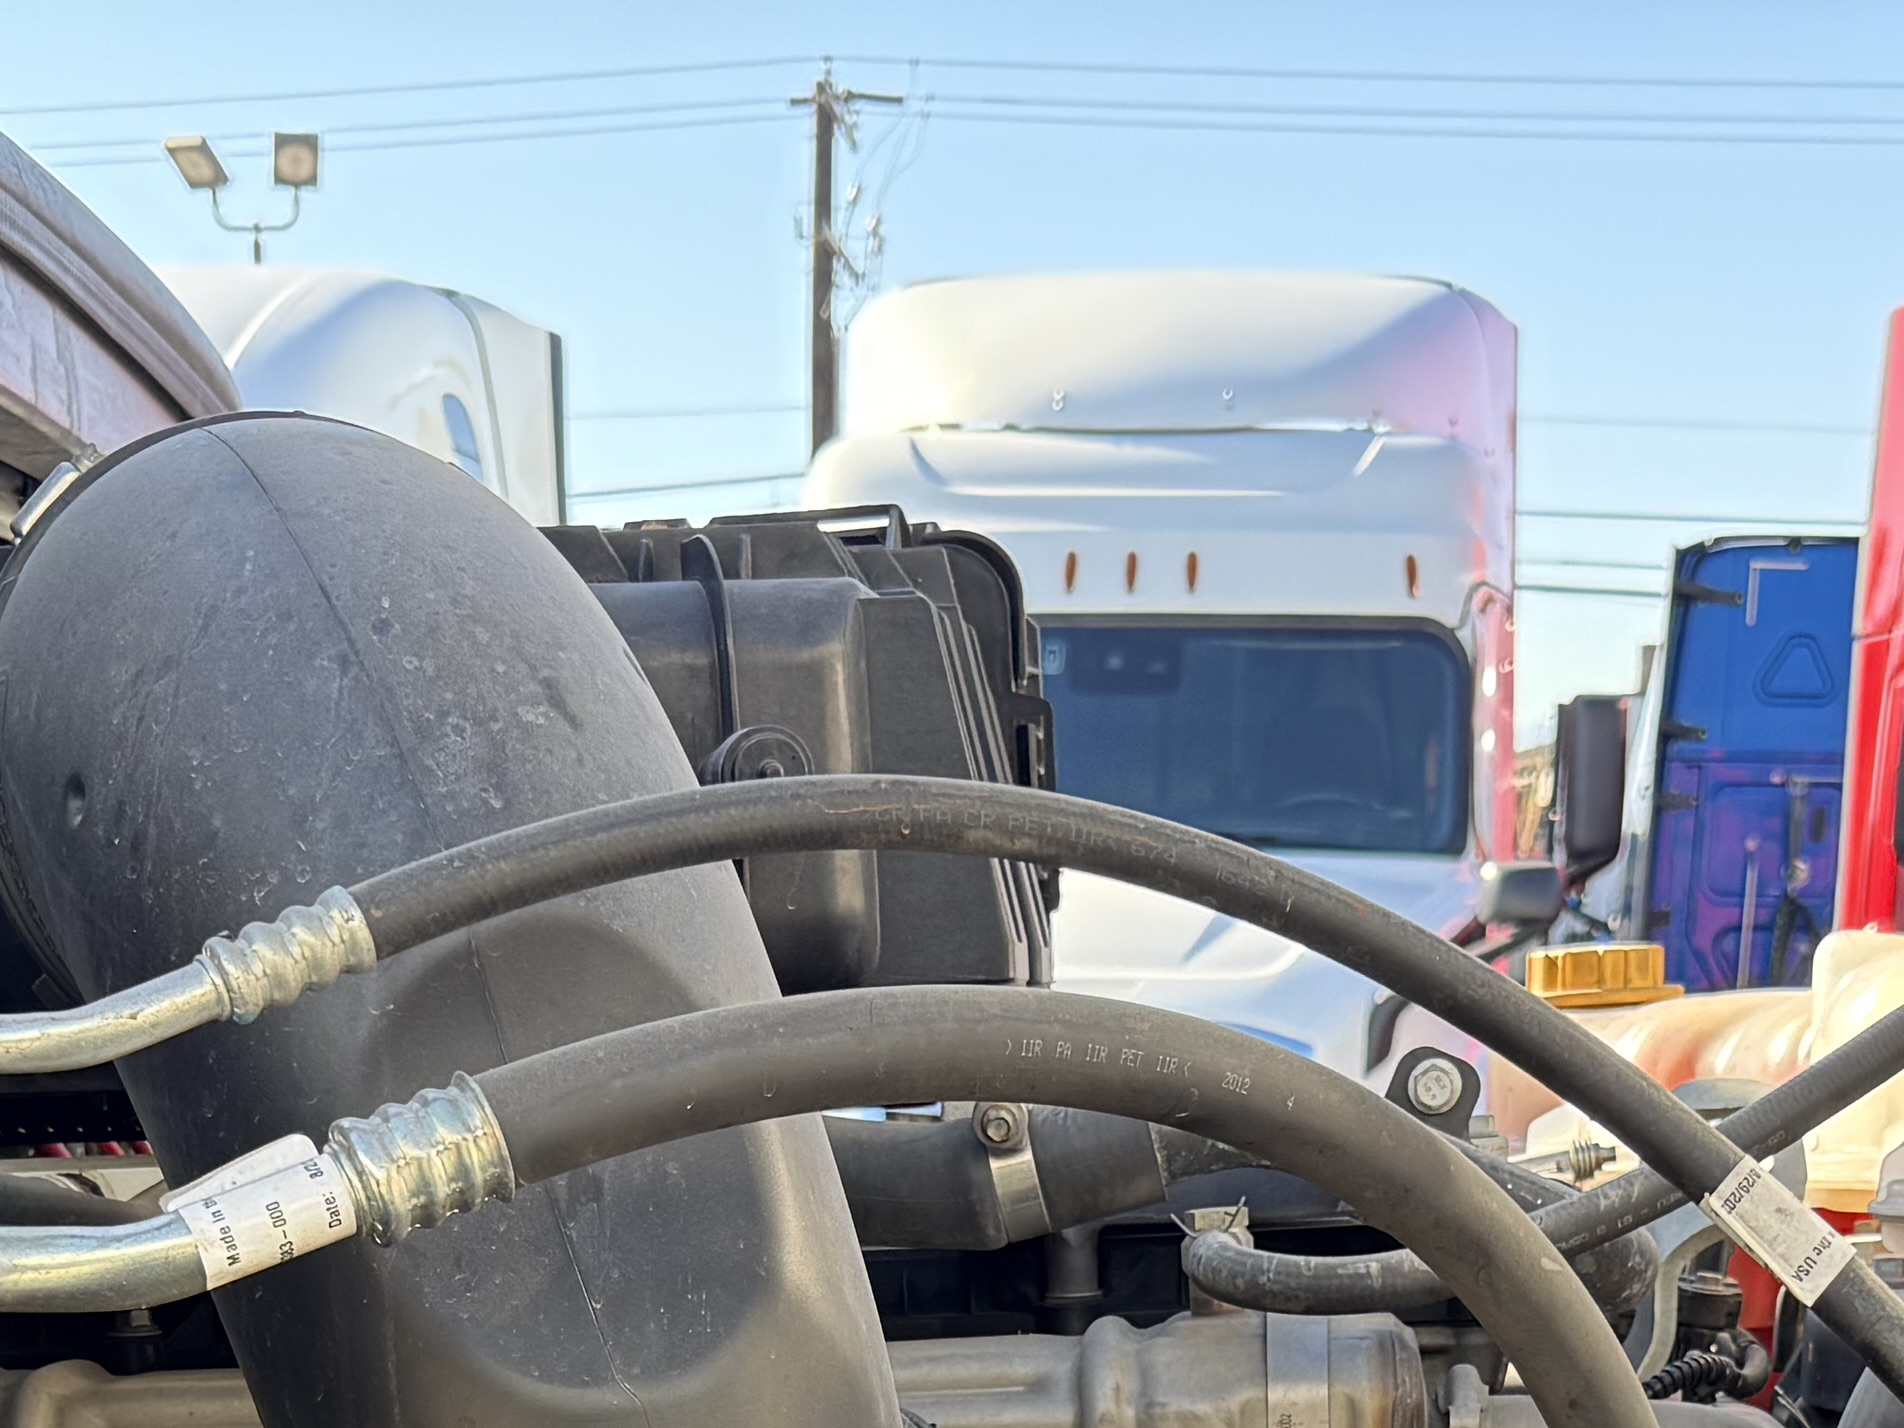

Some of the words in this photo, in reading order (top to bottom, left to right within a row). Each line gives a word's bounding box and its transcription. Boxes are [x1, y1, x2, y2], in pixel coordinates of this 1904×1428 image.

[323, 1191, 342, 1229] Date:
[217, 1225, 241, 1267] Made
[1791, 1256, 1818, 1284] USA
